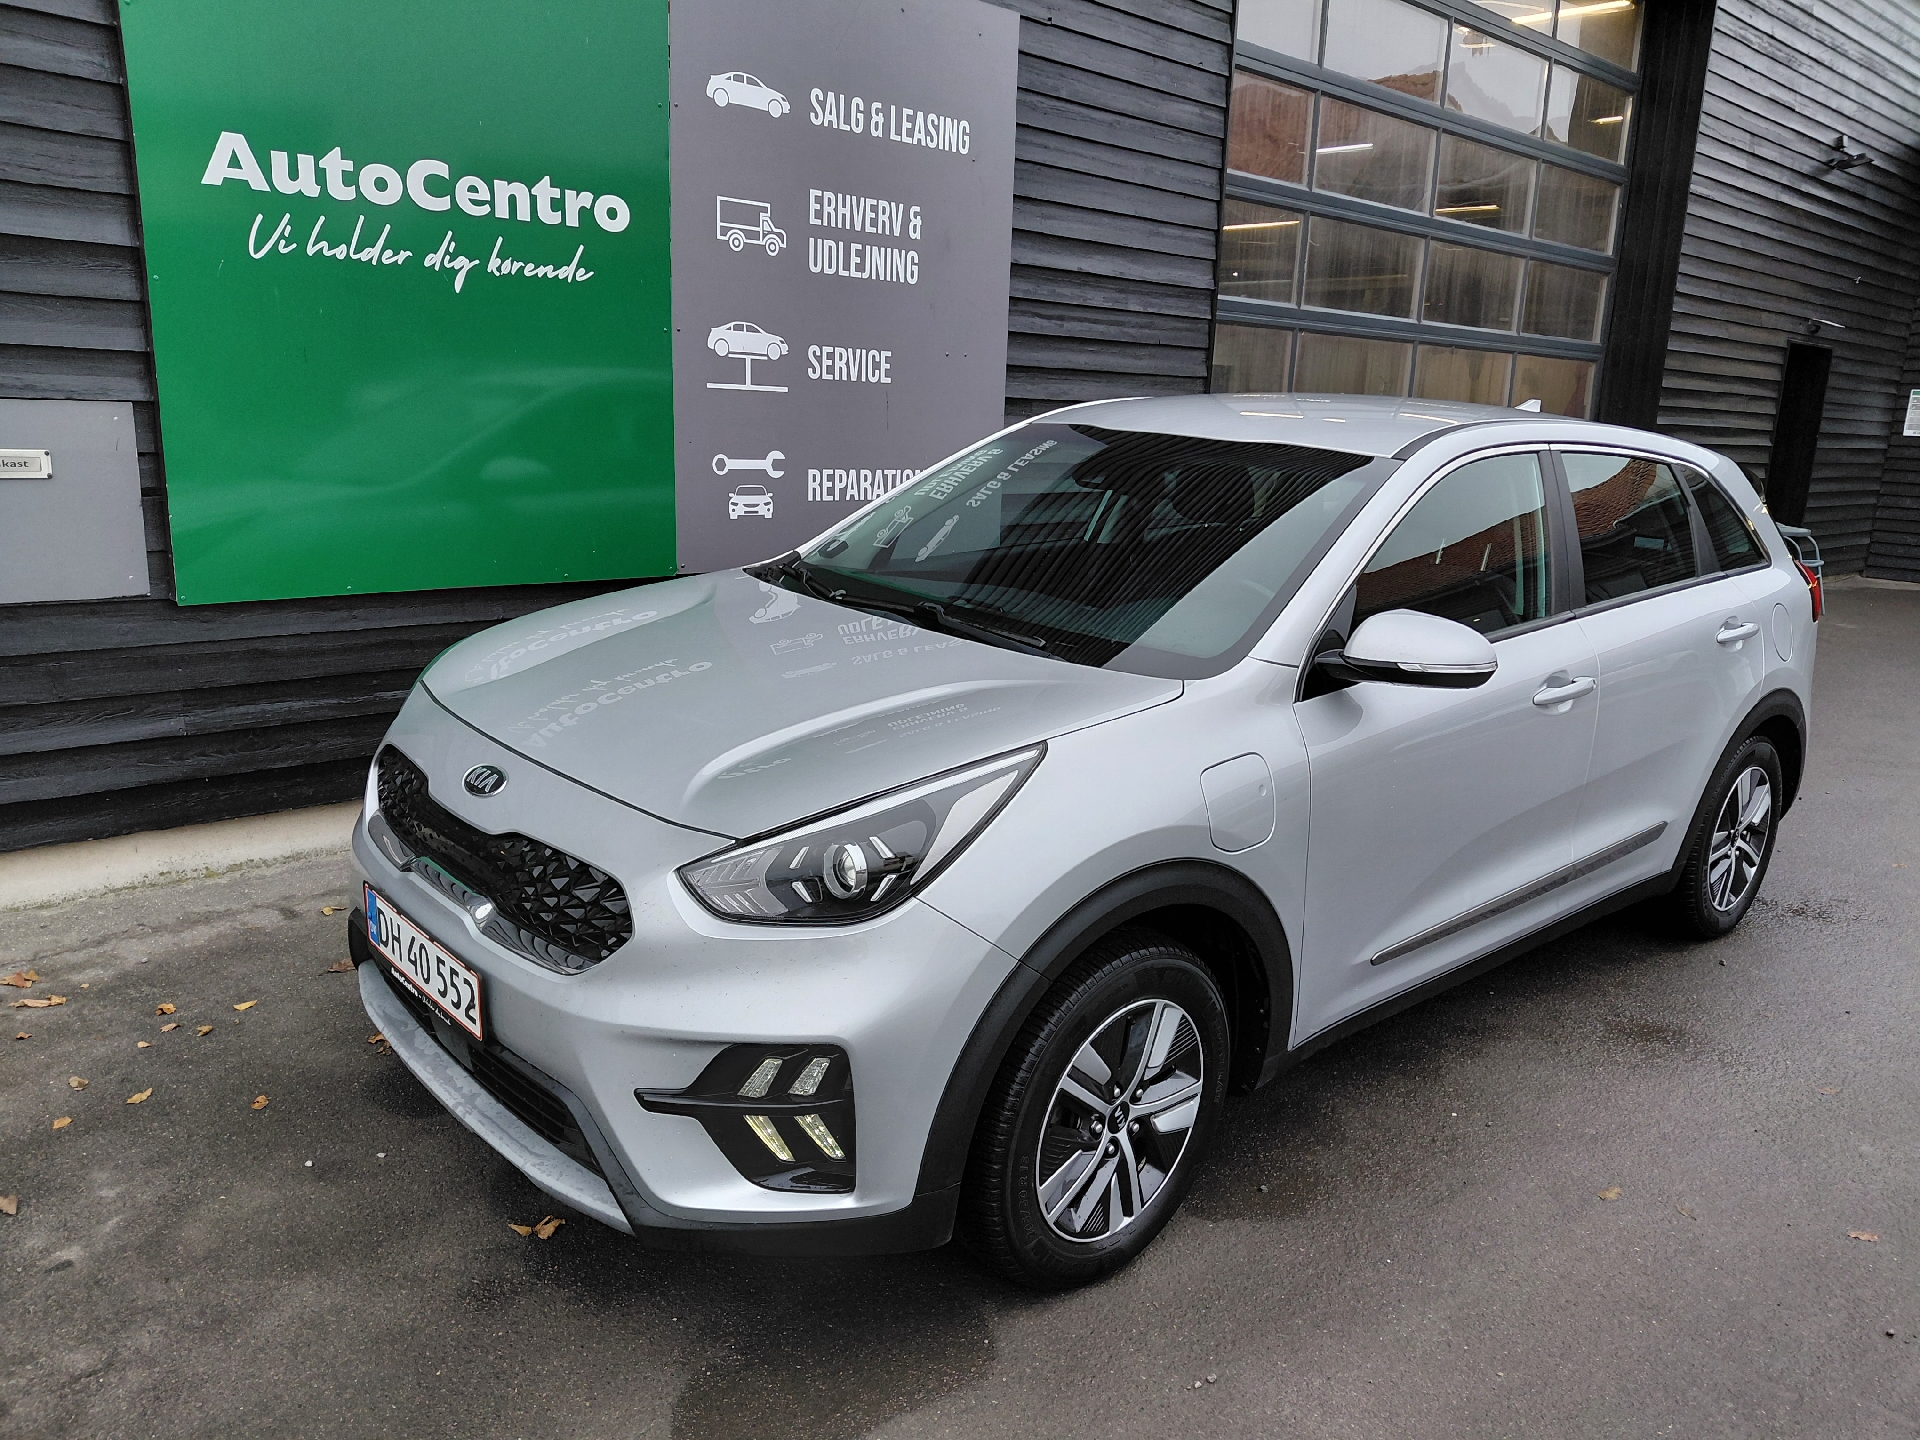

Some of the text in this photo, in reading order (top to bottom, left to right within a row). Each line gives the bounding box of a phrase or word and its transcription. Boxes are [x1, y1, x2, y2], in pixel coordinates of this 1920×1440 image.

[810, 87, 970, 155] SALG & LEASING
[201, 130, 631, 233] AutoCentro
[809, 188, 922, 240] ERHVERV &
[248, 213, 595, 294] Vi holder dig kørende
[808, 237, 919, 285] UDLEJNING
[807, 344, 892, 384] SERVICE
[0, 460, 29, 468] kast
[466, 767, 499, 793] KIA
[377, 906, 403, 963] DH
[407, 936, 431, 984] 40
[436, 954, 477, 1025] 552
